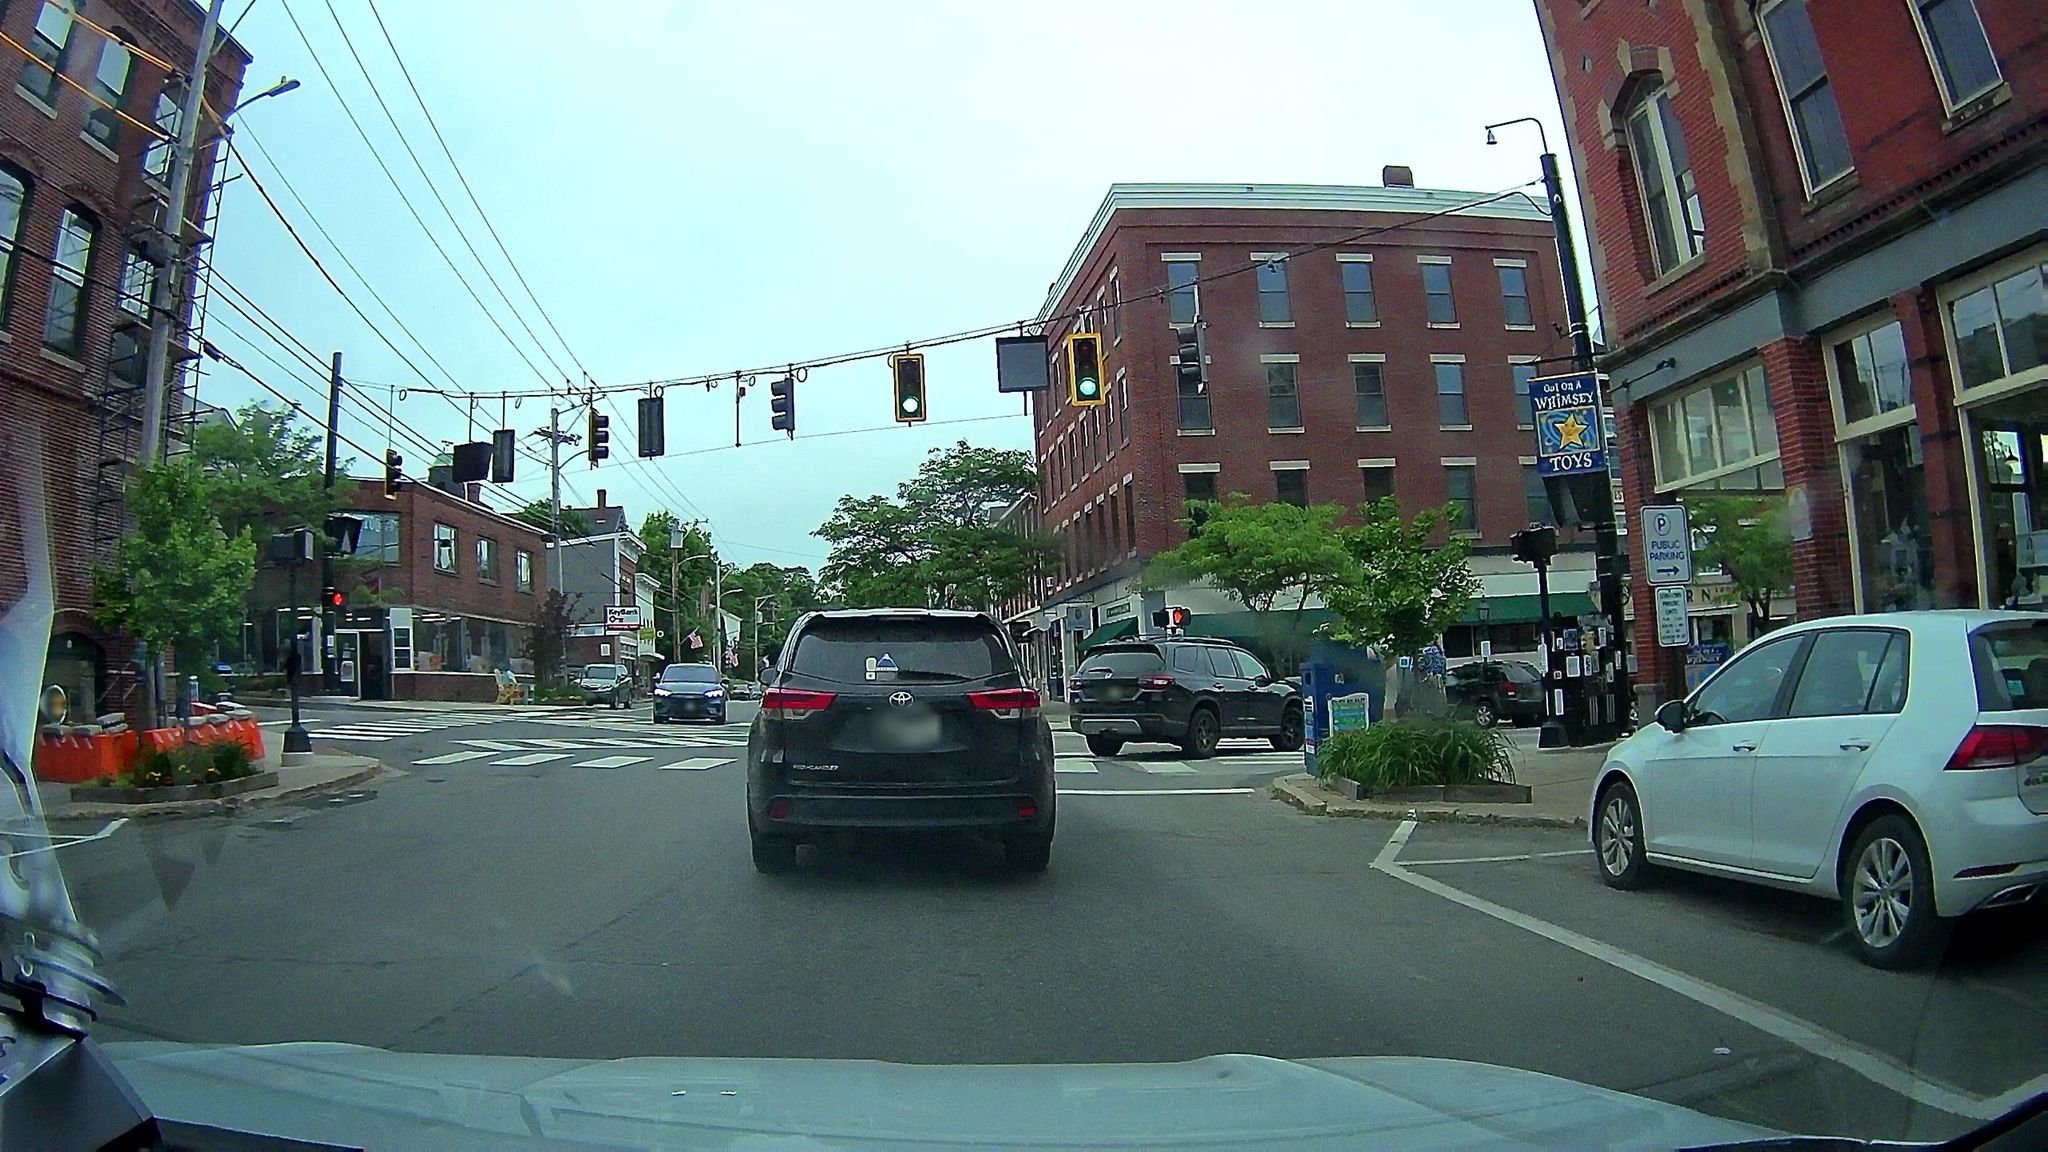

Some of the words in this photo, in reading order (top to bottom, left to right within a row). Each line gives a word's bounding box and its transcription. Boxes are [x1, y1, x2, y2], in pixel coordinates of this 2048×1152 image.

[1561, 382, 1574, 391] On
[1549, 452, 1593, 472] TOYS
[1657, 517, 1667, 531] P
[1651, 540, 1680, 550] PUBLIC
[1649, 551, 1685, 561] PARKING
[608, 608, 638, 616] KeyBank
